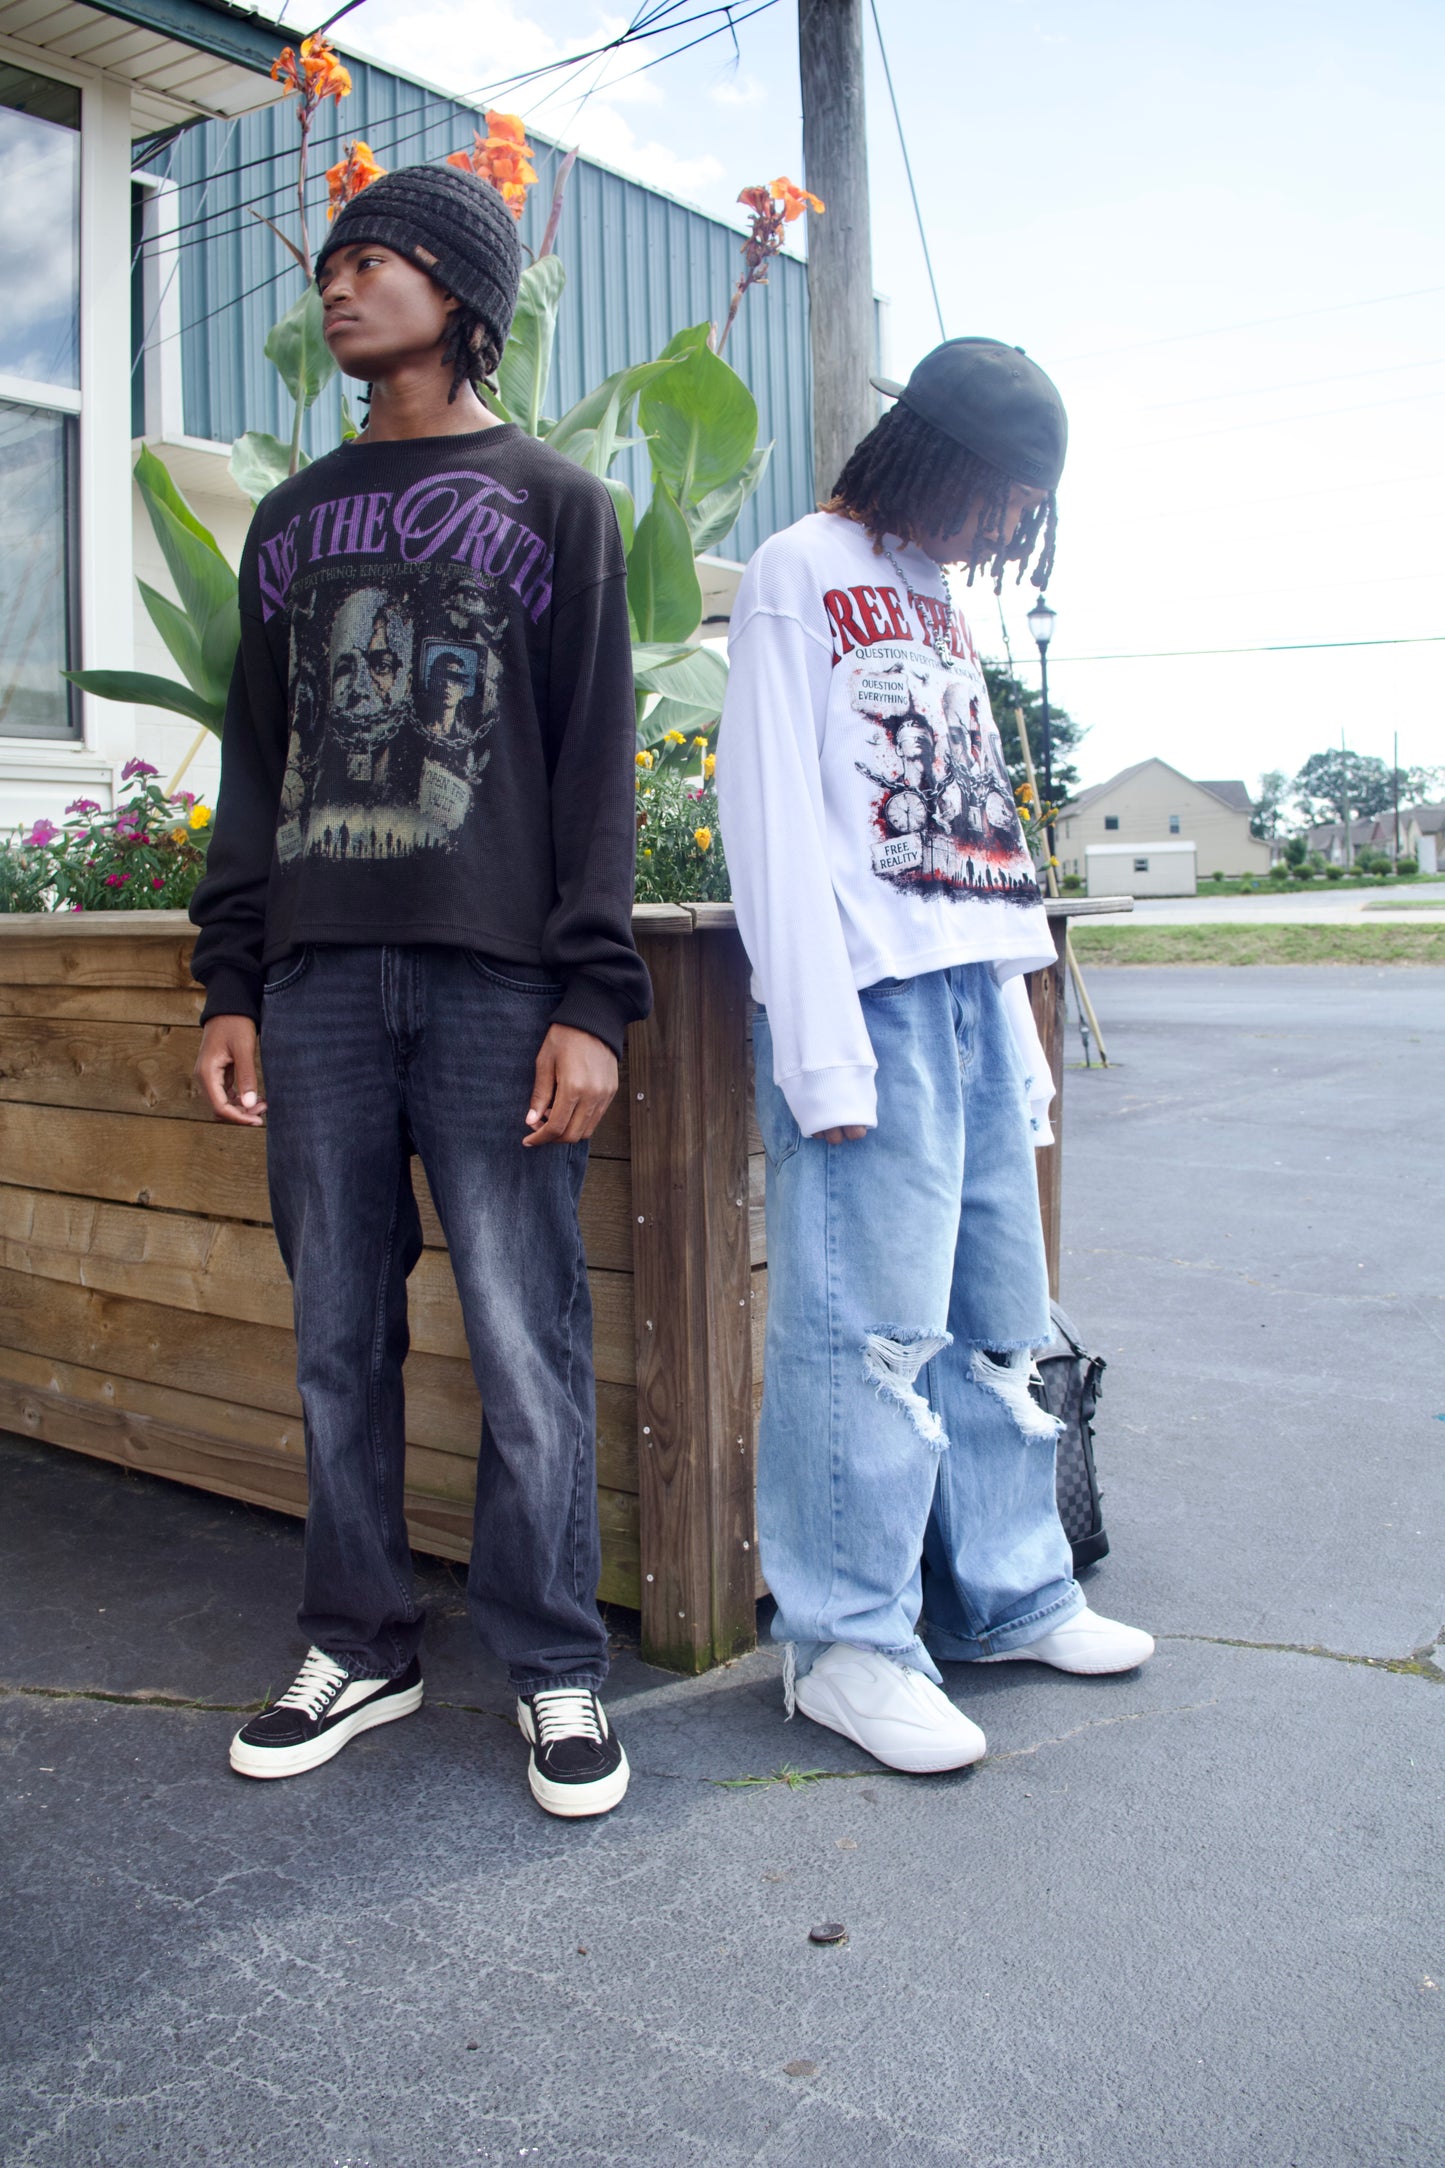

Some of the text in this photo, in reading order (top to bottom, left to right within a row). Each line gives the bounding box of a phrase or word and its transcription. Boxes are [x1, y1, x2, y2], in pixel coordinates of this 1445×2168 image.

[308, 492, 394, 563] THE
[393, 470, 555, 625] TRUTH
[360, 561, 431, 577] KNOWLEDGE
[855, 647, 909, 660] QUESTION
[858, 690, 909, 706] EVERYTHING
[884, 841, 910, 857] FREE
[879, 851, 919, 870] REALITY
